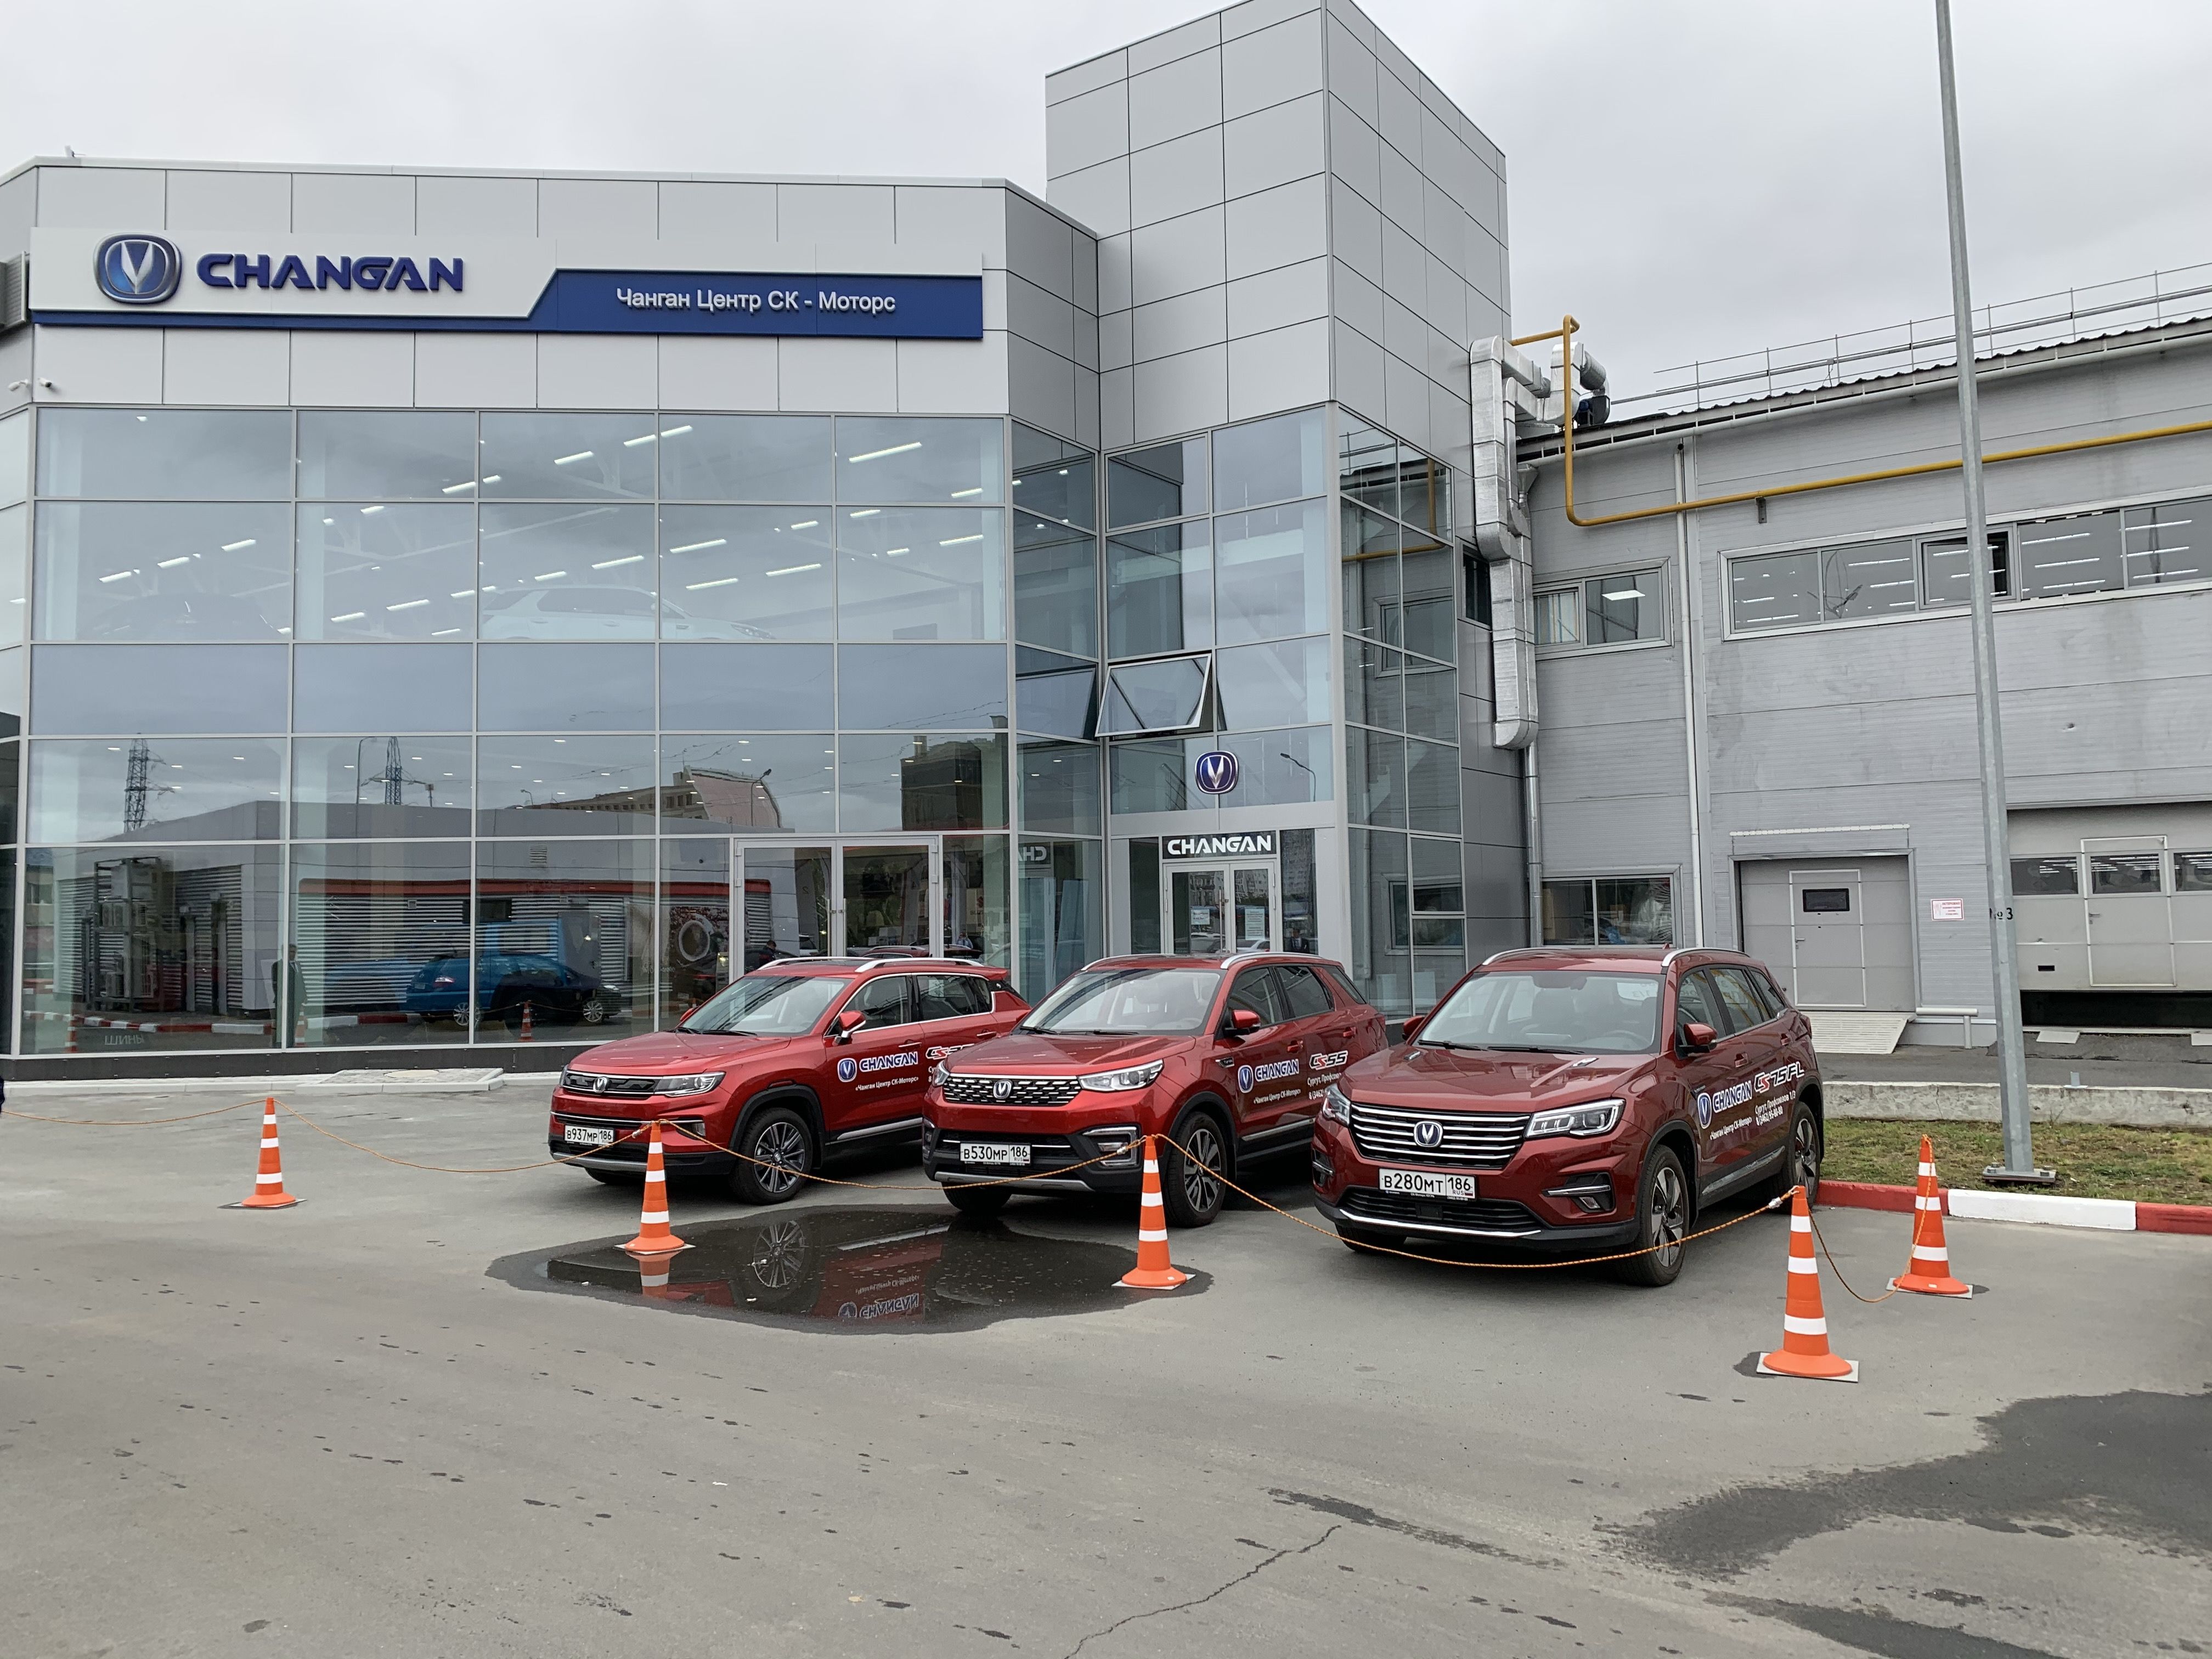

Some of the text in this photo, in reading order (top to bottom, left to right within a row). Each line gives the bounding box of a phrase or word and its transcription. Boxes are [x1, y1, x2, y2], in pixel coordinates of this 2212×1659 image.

[196, 252, 464, 292] CHANGAN
[617, 287, 691, 309] Чанган
[697, 289, 762, 313] Центр
[768, 290, 799, 311] СК
[819, 291, 896, 316] Моторс
[1167, 834, 1271, 855] CHANGAN
[859, 1051, 918, 1073] CHANGAN
[1255, 1058, 1300, 1082] CHANGAN
[1310, 1050, 1348, 1070] CS55
[1713, 1080, 1752, 1113] CHANGAN
[600, 1130, 612, 1140] 186
[1011, 1146, 1028, 1157] 186
[1447, 1177, 1471, 1191] 186
